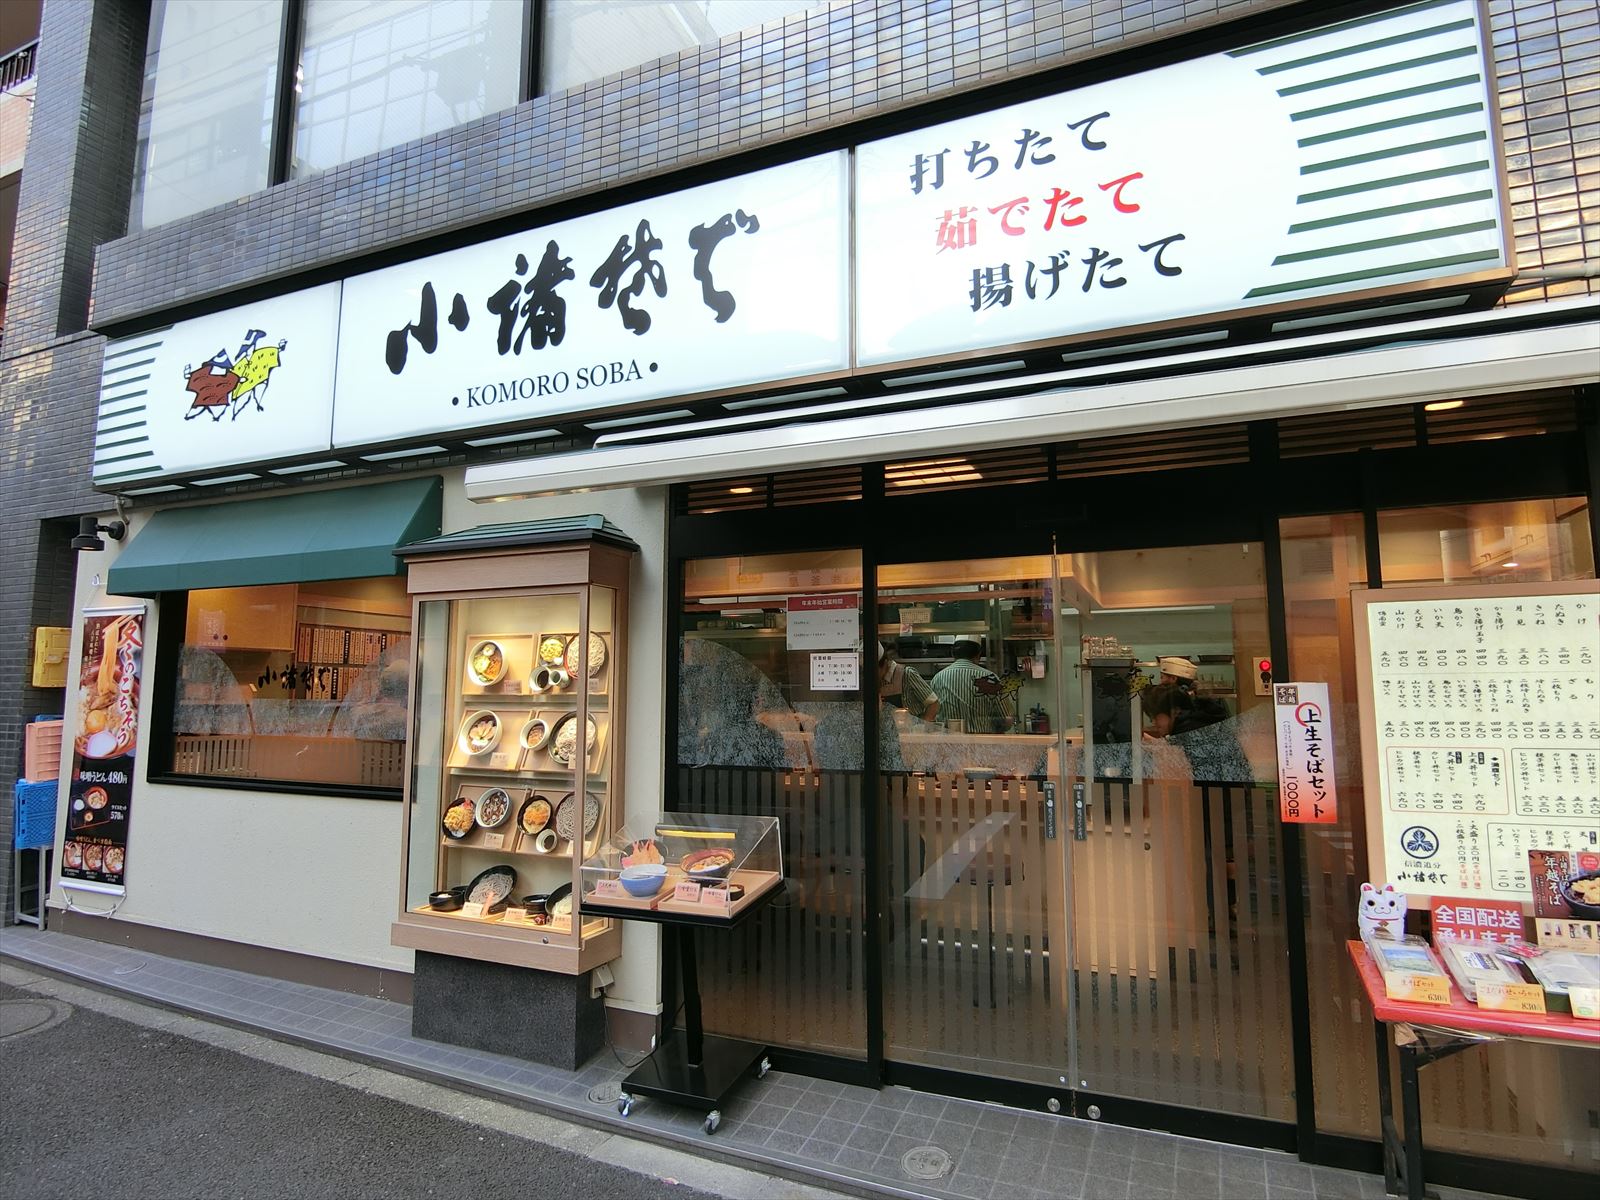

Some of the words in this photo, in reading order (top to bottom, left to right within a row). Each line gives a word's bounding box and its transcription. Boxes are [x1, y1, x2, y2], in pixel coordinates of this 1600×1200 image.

[909, 111, 1111, 195] 打ちたて
[935, 172, 1144, 255] 茹でたて
[969, 233, 1186, 312] 揚げたて
[466, 371, 570, 408] KOMORO
[576, 359, 643, 390] SOBA
[1395, 610, 1405, 629] 山かけ
[1434, 608, 1444, 628] いか天
[1515, 605, 1526, 626] 月見
[1555, 603, 1565, 625] たぬき
[1304, 708, 1327, 818] 上生そばセット
[1544, 856, 1560, 905] 年越そば
[1434, 904, 1521, 929] 全国配送
